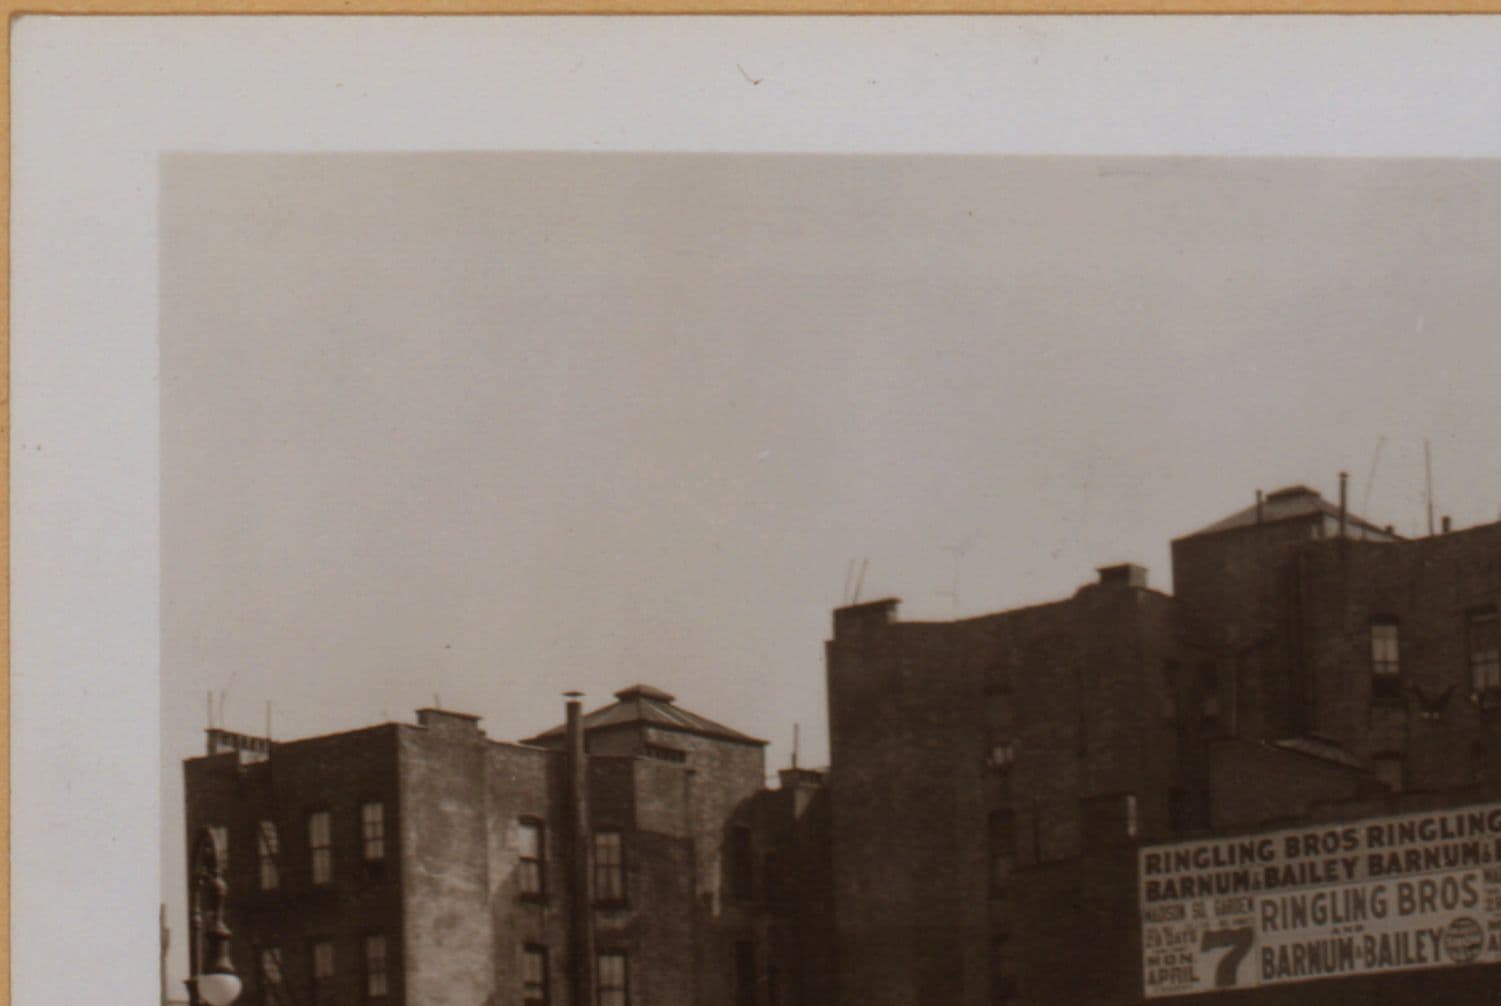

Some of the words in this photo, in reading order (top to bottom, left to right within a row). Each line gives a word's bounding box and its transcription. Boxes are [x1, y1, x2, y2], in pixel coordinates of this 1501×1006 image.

[1145, 839, 1275, 876] RINGLING
[1285, 828, 1359, 858] BROS
[1368, 841, 1479, 877] BARNUM
[1146, 869, 1250, 902] BARNUM
[1263, 856, 1359, 888] BAILEY
[1260, 875, 1387, 932] RINGLING
[1398, 873, 1478, 916] BROS
[1147, 952, 1193, 966] MON
[1147, 964, 1200, 985] APRIL
[1200, 926, 1254, 986] 7
[1261, 936, 1354, 980] BARNUM
[1364, 927, 1443, 969] BAILEY
